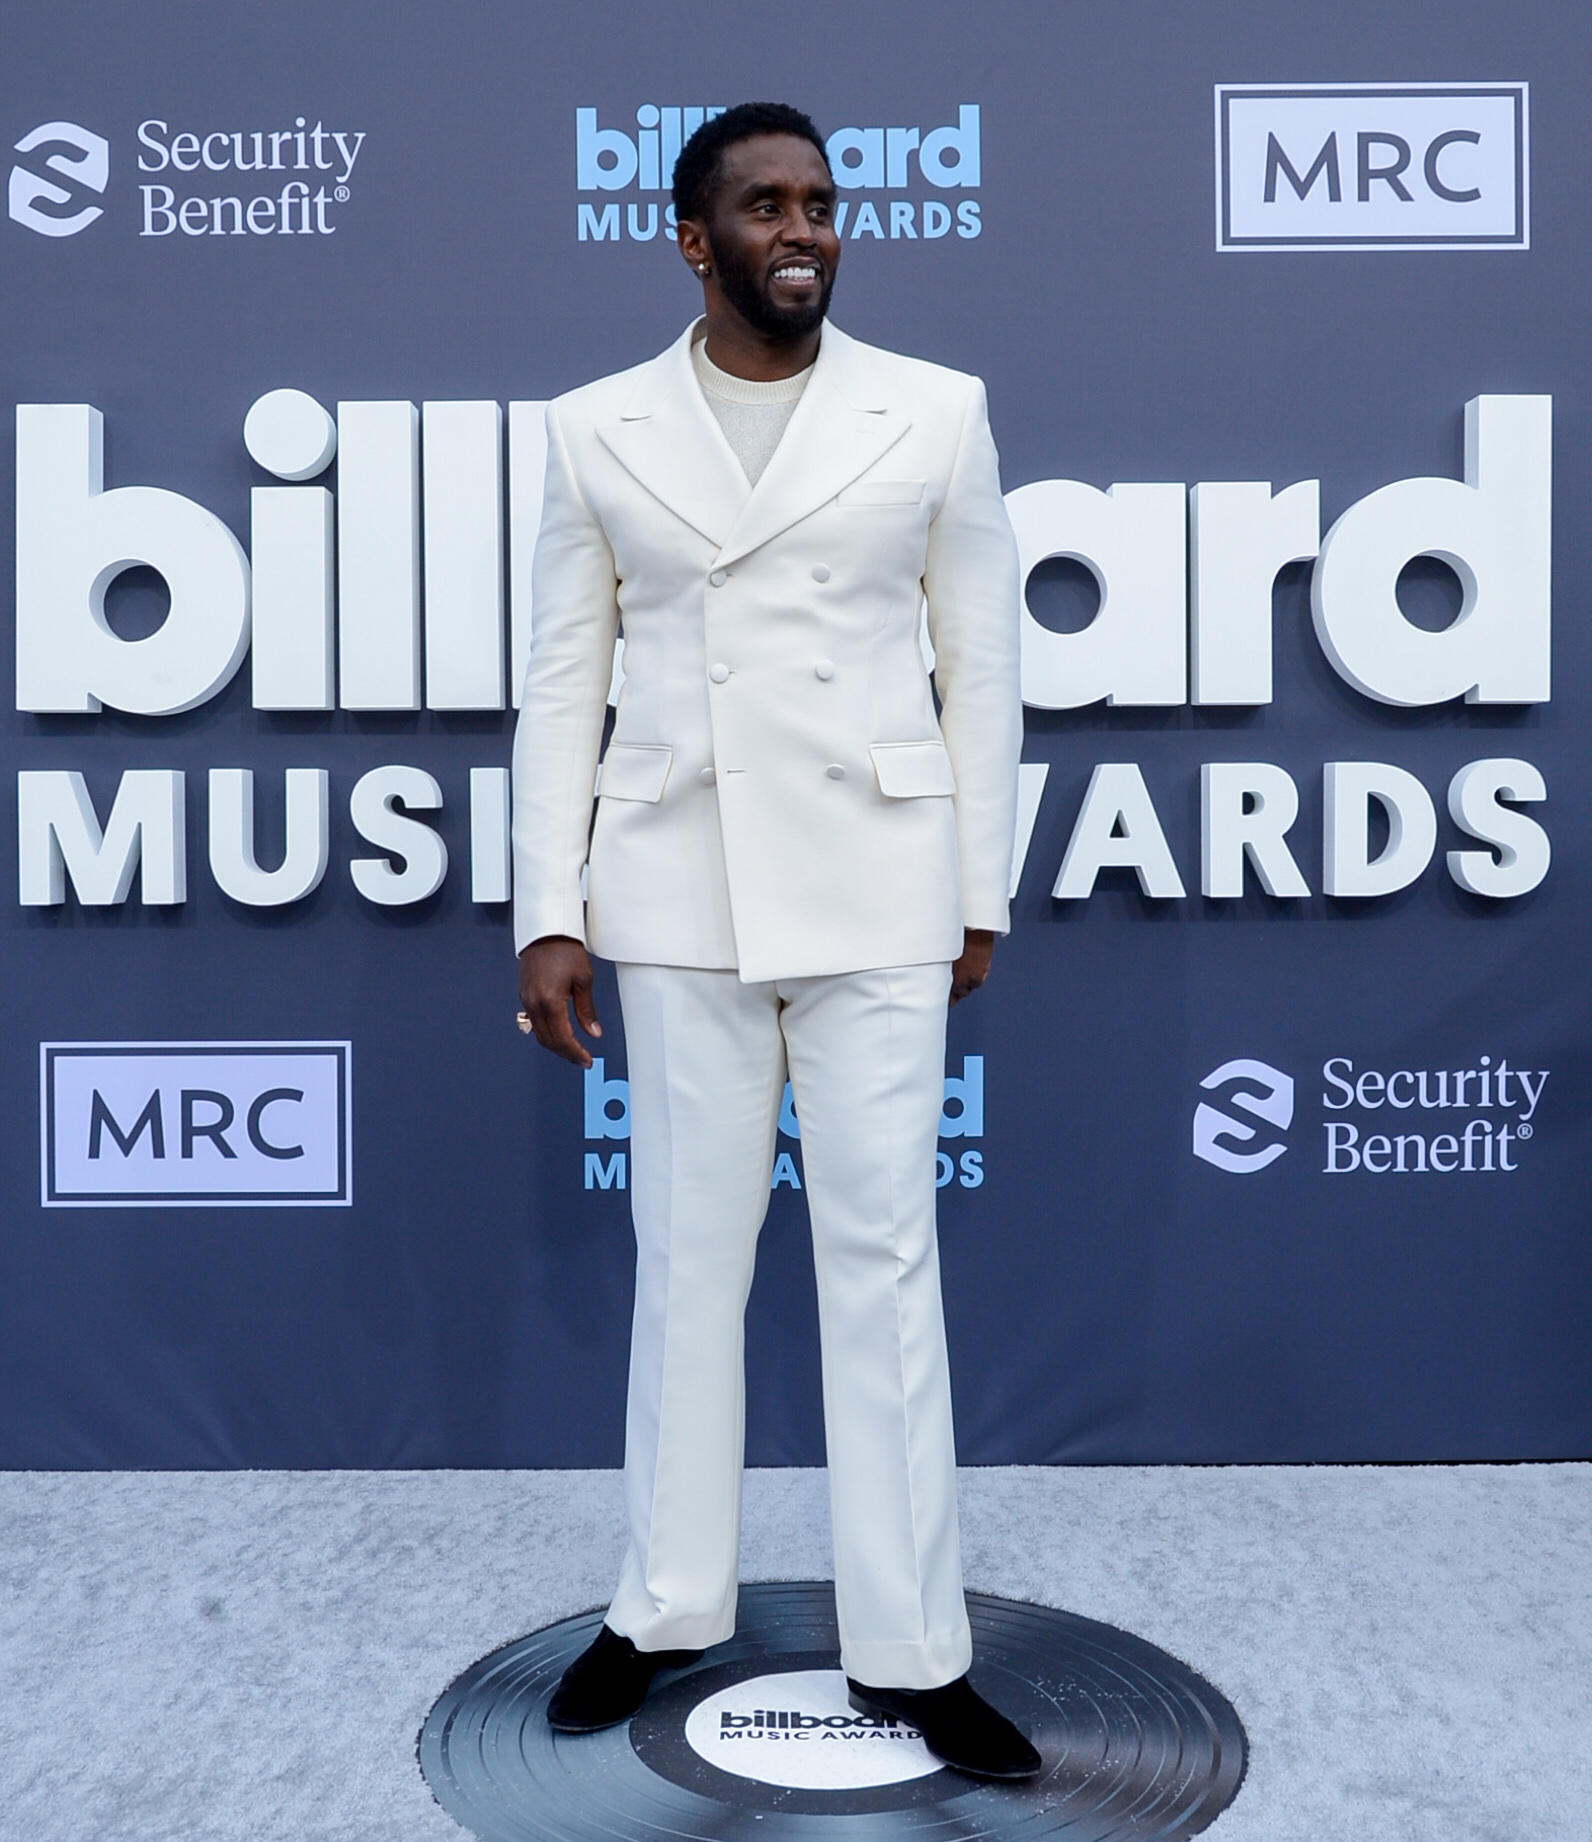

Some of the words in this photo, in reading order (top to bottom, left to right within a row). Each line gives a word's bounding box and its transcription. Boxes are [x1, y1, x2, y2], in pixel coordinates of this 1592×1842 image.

[137, 116, 366, 183] Security
[1263, 129, 1482, 203] MRC
[833, 200, 982, 240] ARDS
[16, 388, 1552, 716] billard
[17, 764, 511, 907] MUSI
[1009, 758, 1551, 899] ARDS
[1322, 1056, 1551, 1120] Security
[88, 1087, 305, 1160] MRC
[720, 1730, 811, 1741] MUSIC
